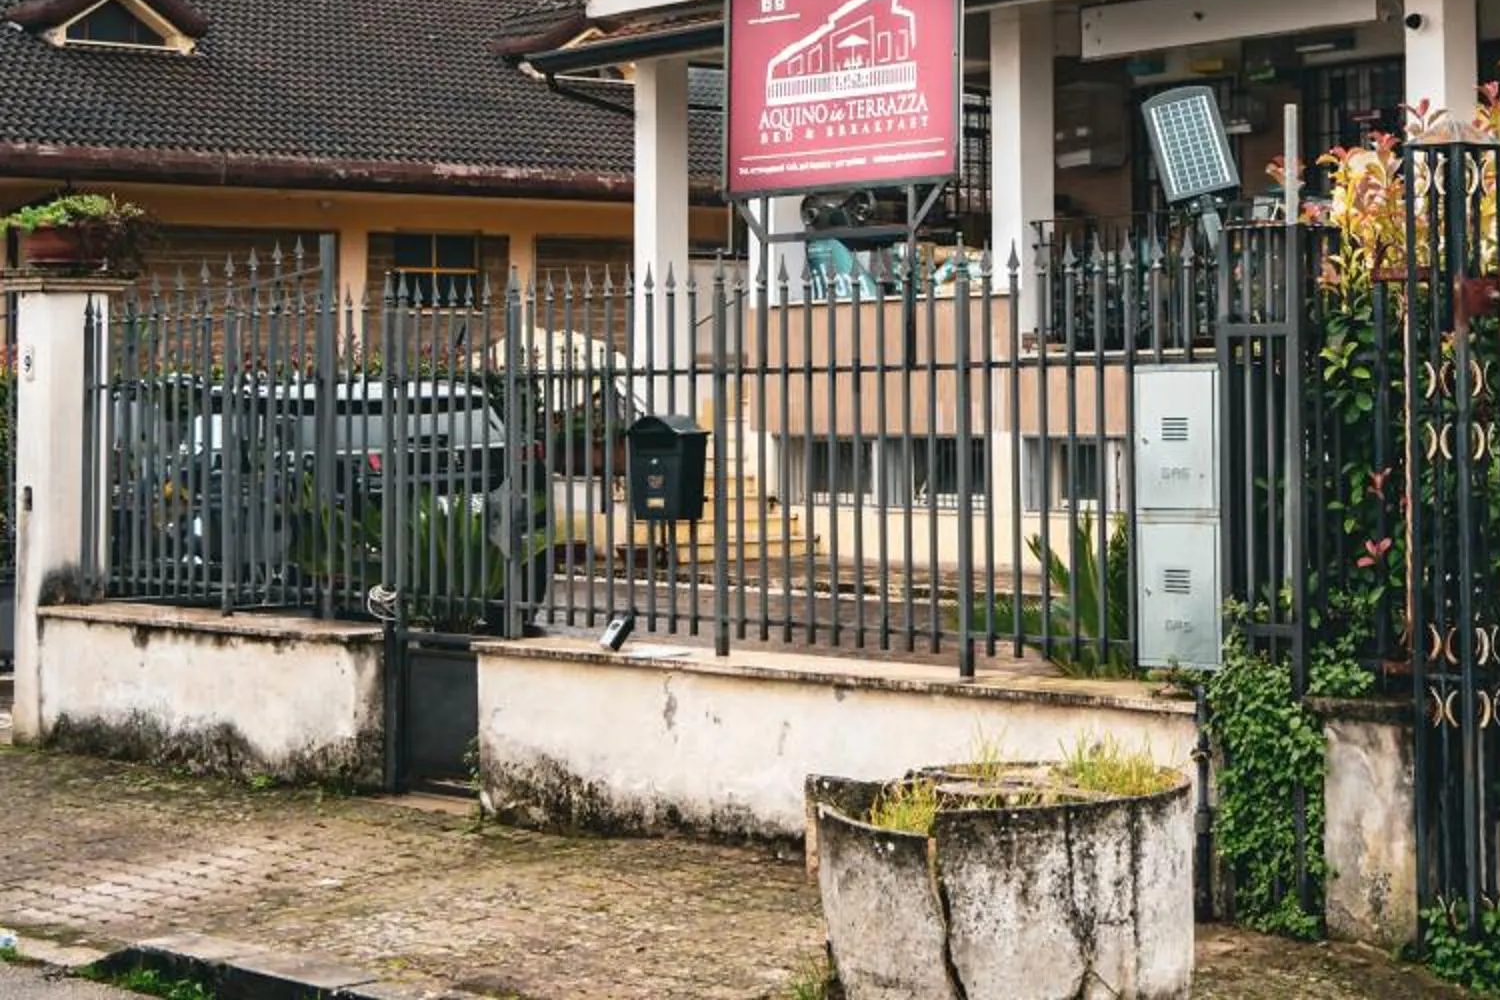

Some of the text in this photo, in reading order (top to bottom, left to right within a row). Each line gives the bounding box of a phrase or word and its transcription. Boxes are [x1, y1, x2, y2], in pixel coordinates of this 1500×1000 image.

[759, 92, 928, 131] AQUINO in TERRAZZA
[760, 115, 929, 144] BED & BREAKFAST
